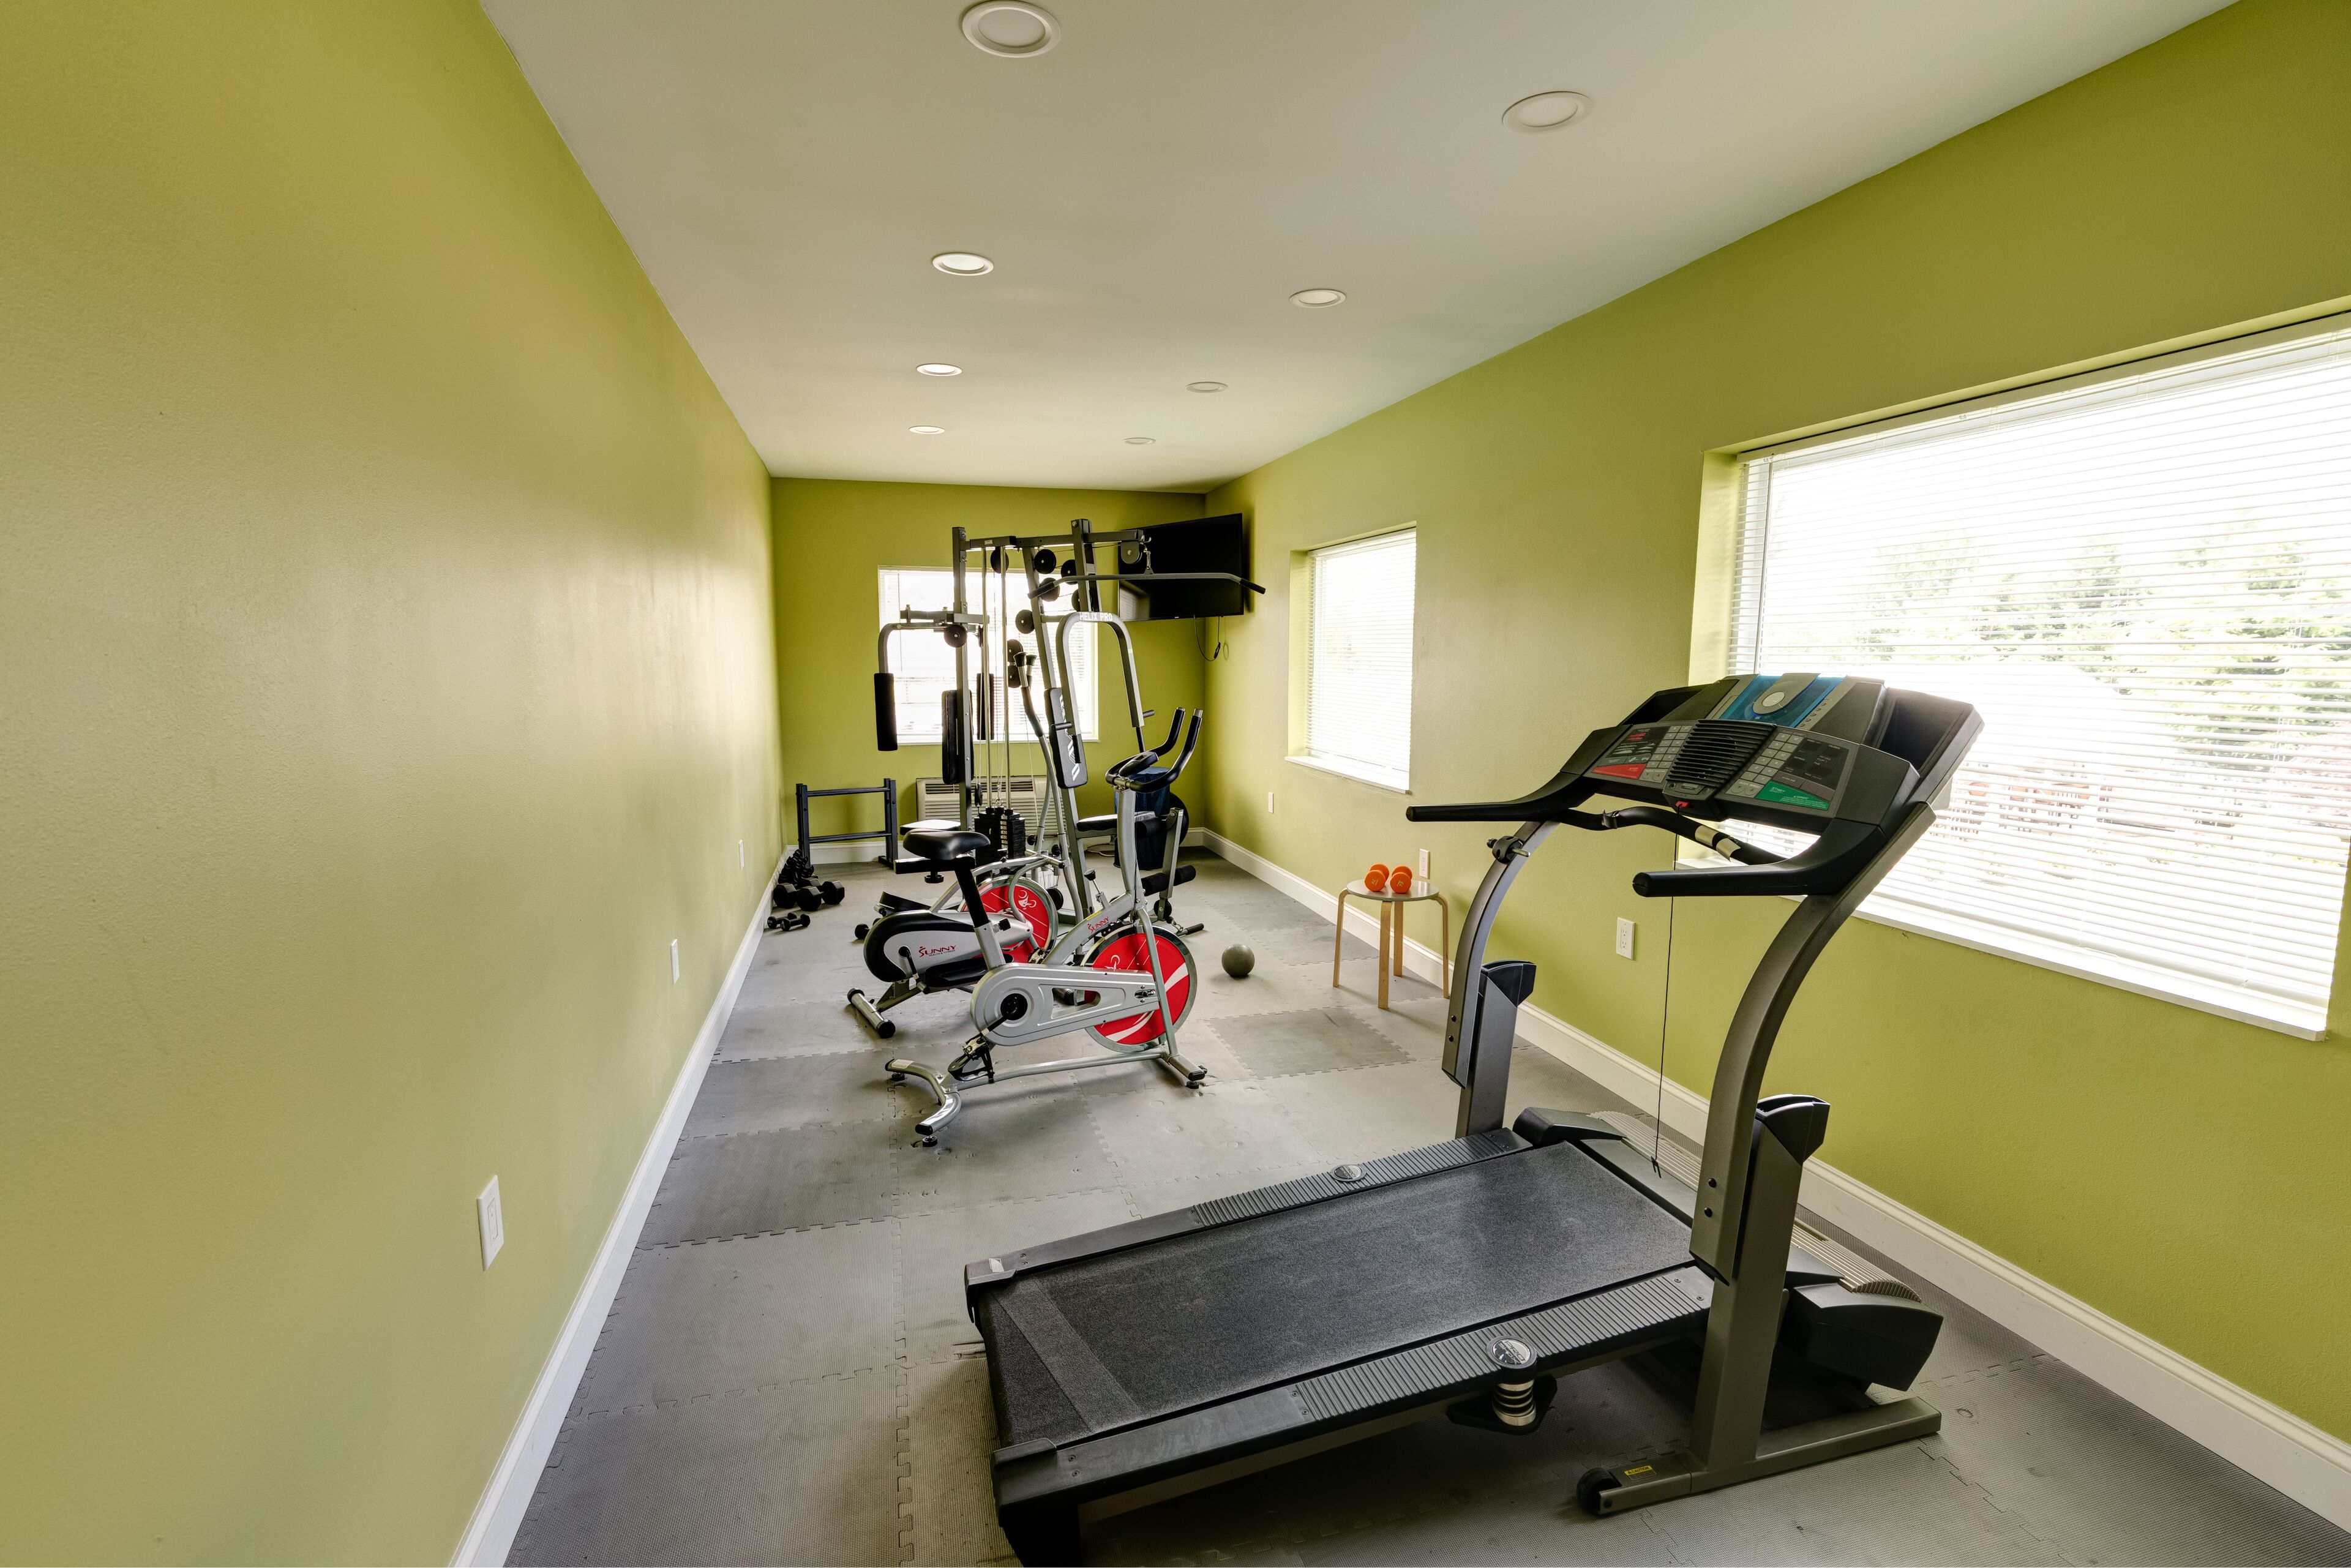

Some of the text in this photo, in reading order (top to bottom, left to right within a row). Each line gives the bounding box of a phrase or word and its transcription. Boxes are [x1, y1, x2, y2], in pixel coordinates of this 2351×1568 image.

[1079, 612, 1113, 622] HELIX PRO
[1087, 917, 1109, 934] SUNNY
[918, 945, 956, 958] SUNNY
[1504, 1341, 1526, 1361] PRO
